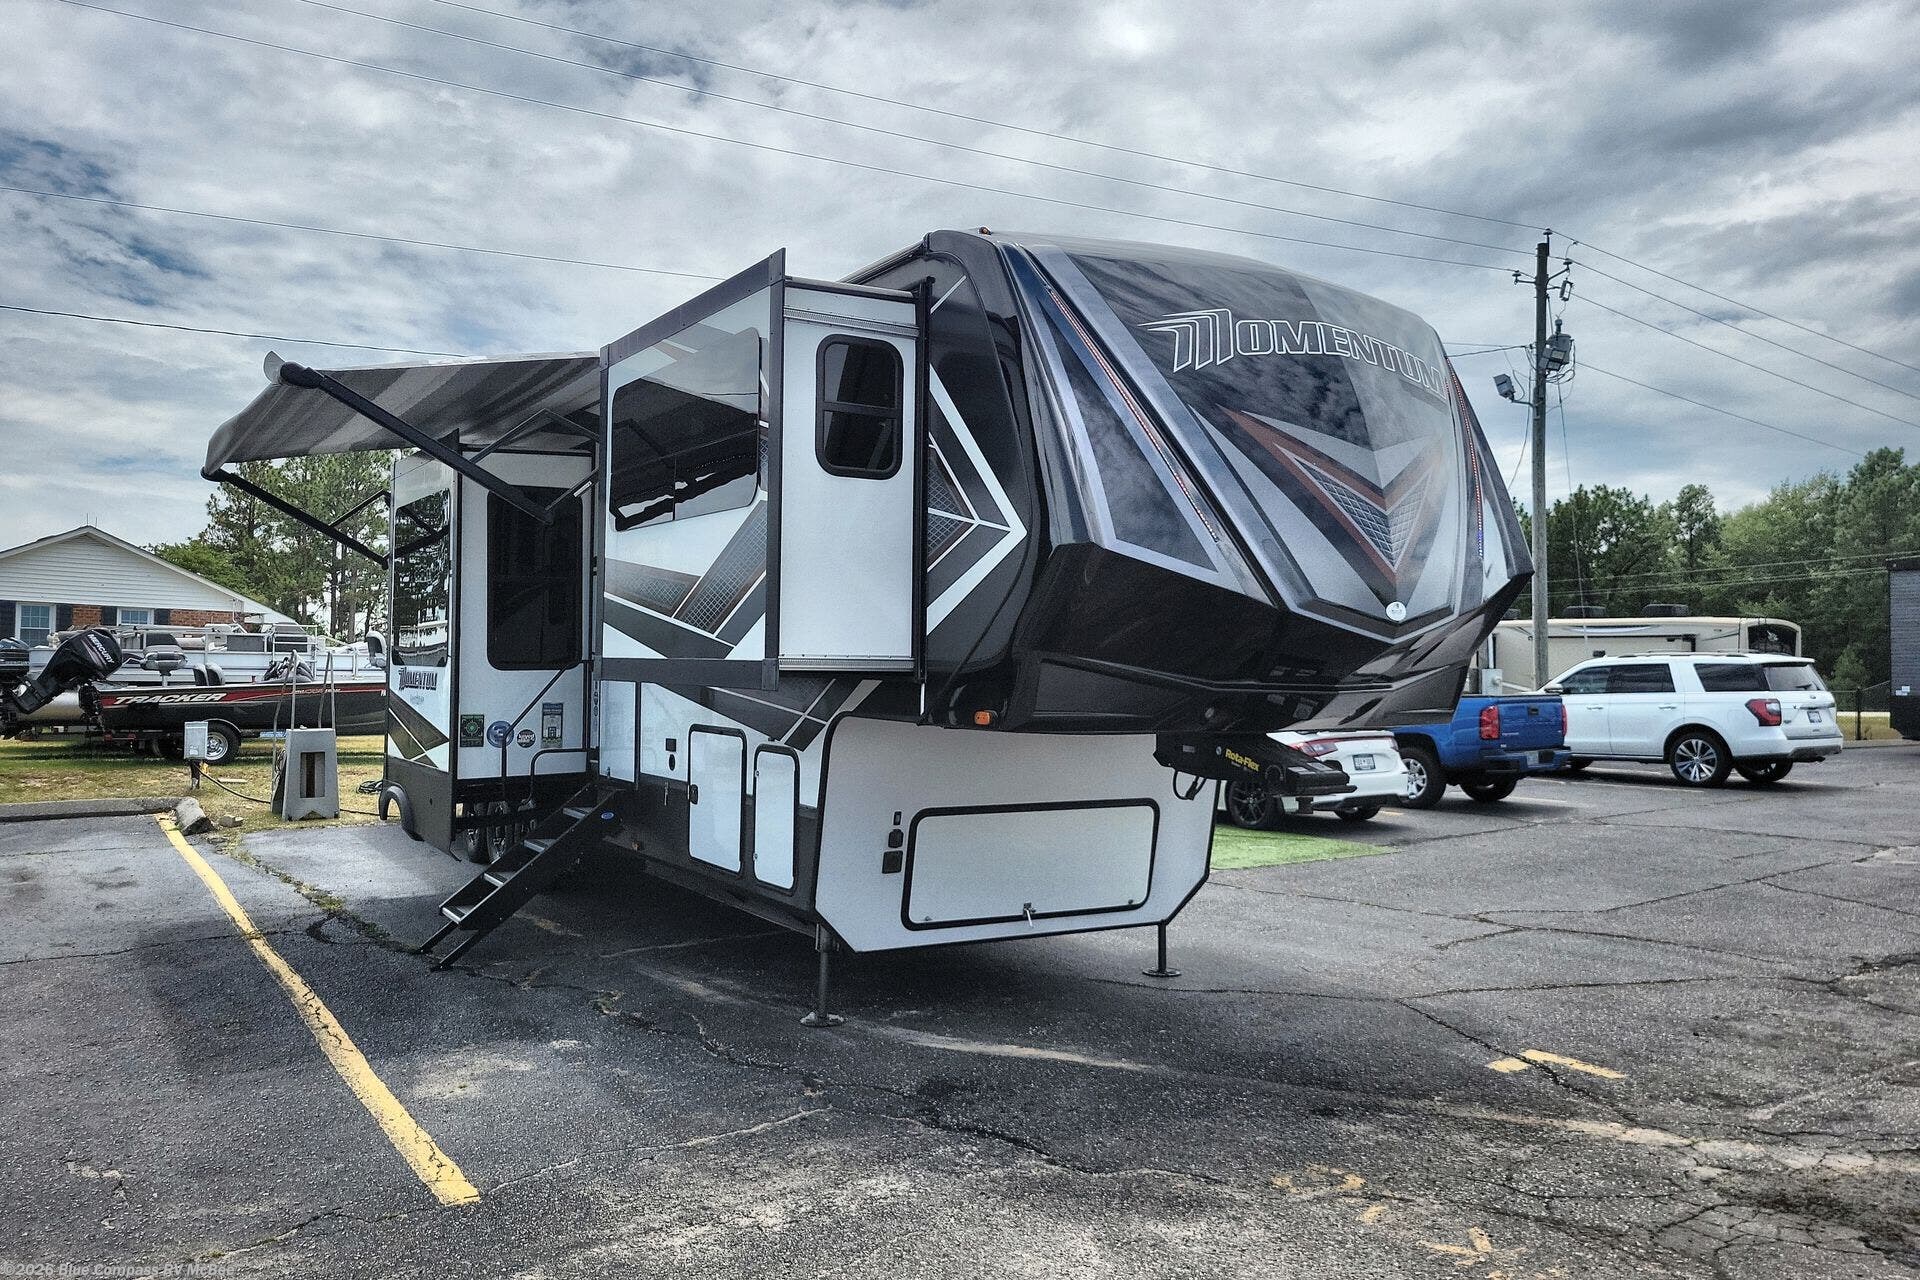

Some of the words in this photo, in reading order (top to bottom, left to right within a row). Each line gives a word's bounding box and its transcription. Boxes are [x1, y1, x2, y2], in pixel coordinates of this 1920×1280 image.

[1137, 308, 1447, 401] MOMENTUM
[87, 633, 115, 664] MERCURY
[398, 666, 438, 691] MOMENTUM
[113, 692, 227, 705] TRACKER
[1225, 748, 1260, 772] Rota-Flex
